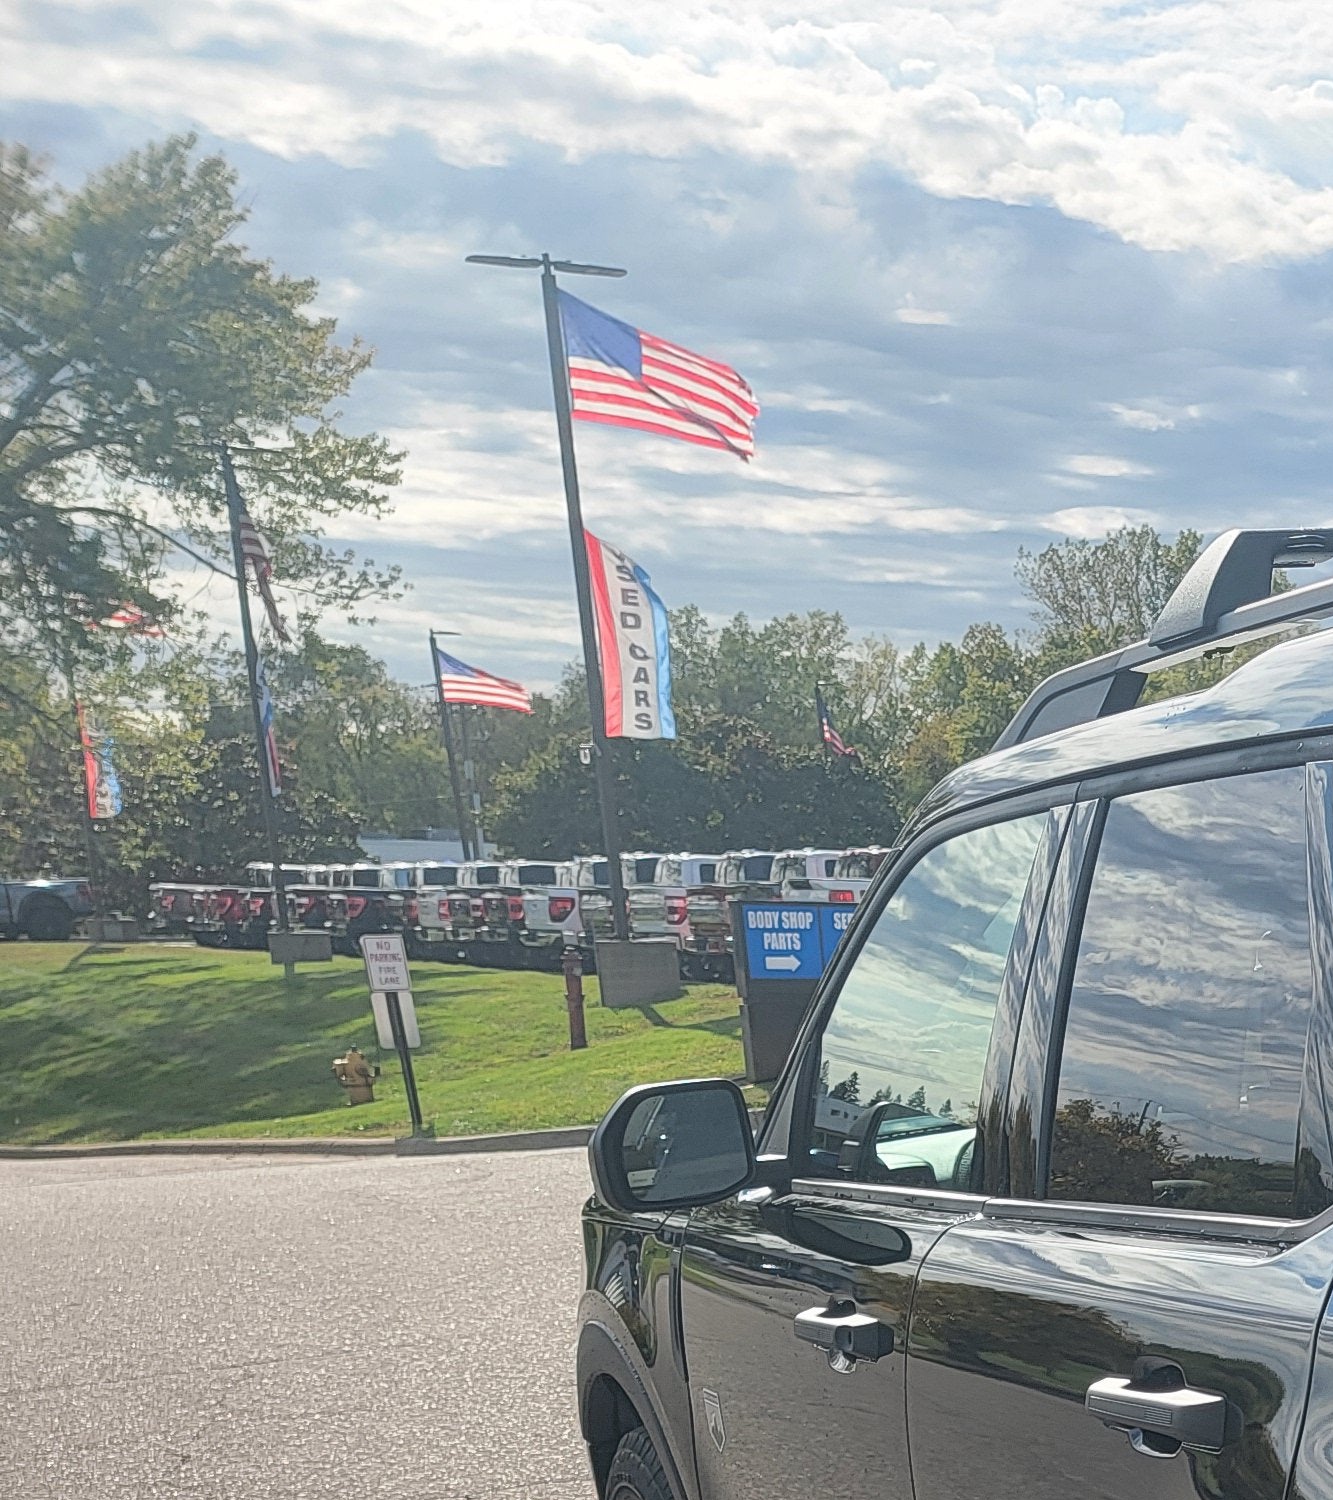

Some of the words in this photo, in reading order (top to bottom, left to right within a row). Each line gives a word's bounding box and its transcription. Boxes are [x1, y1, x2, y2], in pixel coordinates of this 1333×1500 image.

[628, 643, 653, 731] CARS
[747, 911, 780, 929] BODY
[781, 911, 814, 930] SHOP
[375, 941, 391, 951] NO
[763, 932, 801, 951] PARTS
[369, 953, 403, 963] PARKING
